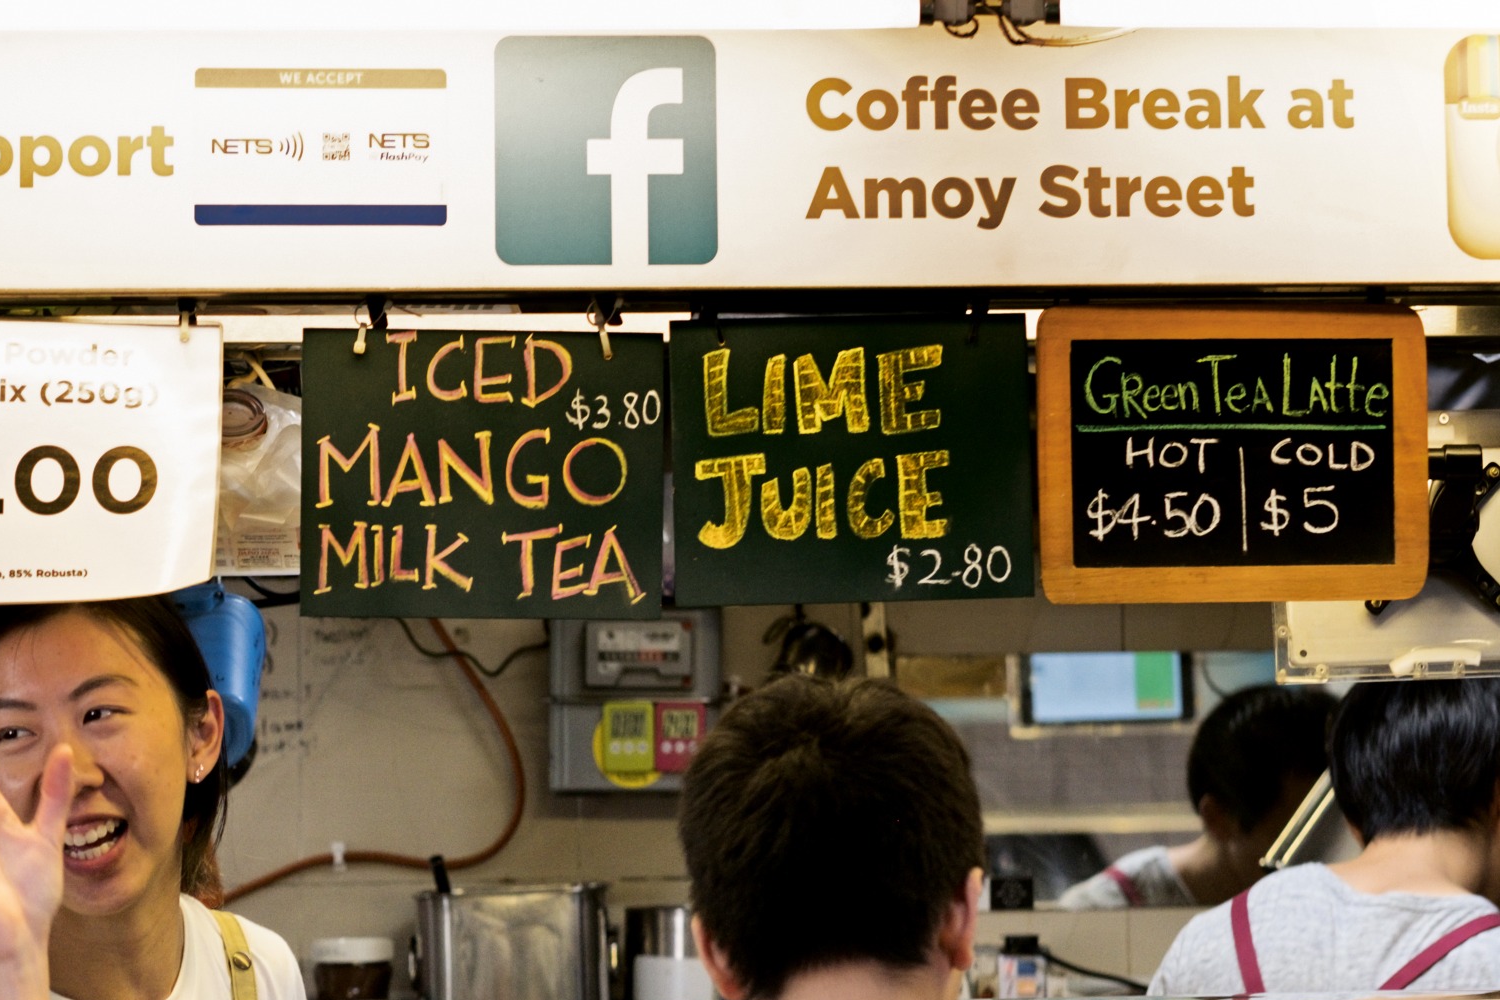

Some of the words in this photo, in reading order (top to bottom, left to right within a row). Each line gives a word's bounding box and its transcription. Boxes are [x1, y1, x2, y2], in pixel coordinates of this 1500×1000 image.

[279, 71, 301, 84] WE
[306, 71, 363, 84] ACCEPT
[805, 74, 1041, 132] Coffee
[1063, 75, 1266, 130] Break
[1286, 77, 1355, 130] at
[211, 138, 273, 155] NETS
[368, 133, 430, 149] NETS
[379, 152, 429, 164] FlashPay
[805, 166, 1017, 231] Amoy
[1037, 164, 1256, 219] Street
[5, 341, 135, 368] Powder
[386, 330, 573, 408] ICED
[40, 380, 159, 409] (250g)
[565, 388, 662, 430] $3.80
[702, 344, 944, 437] LIME
[315, 422, 628, 510] MANGO
[1125, 437, 1220, 474] HOT
[1270, 437, 1375, 472] COLD
[694, 449, 950, 550] JUICE
[1086, 489, 1221, 542] $4.50
[8, 568, 33, 579] 85%
[36, 567, 88, 579] Robusta)
[313, 521, 474, 595] MILK
[501, 523, 646, 606] TEA
